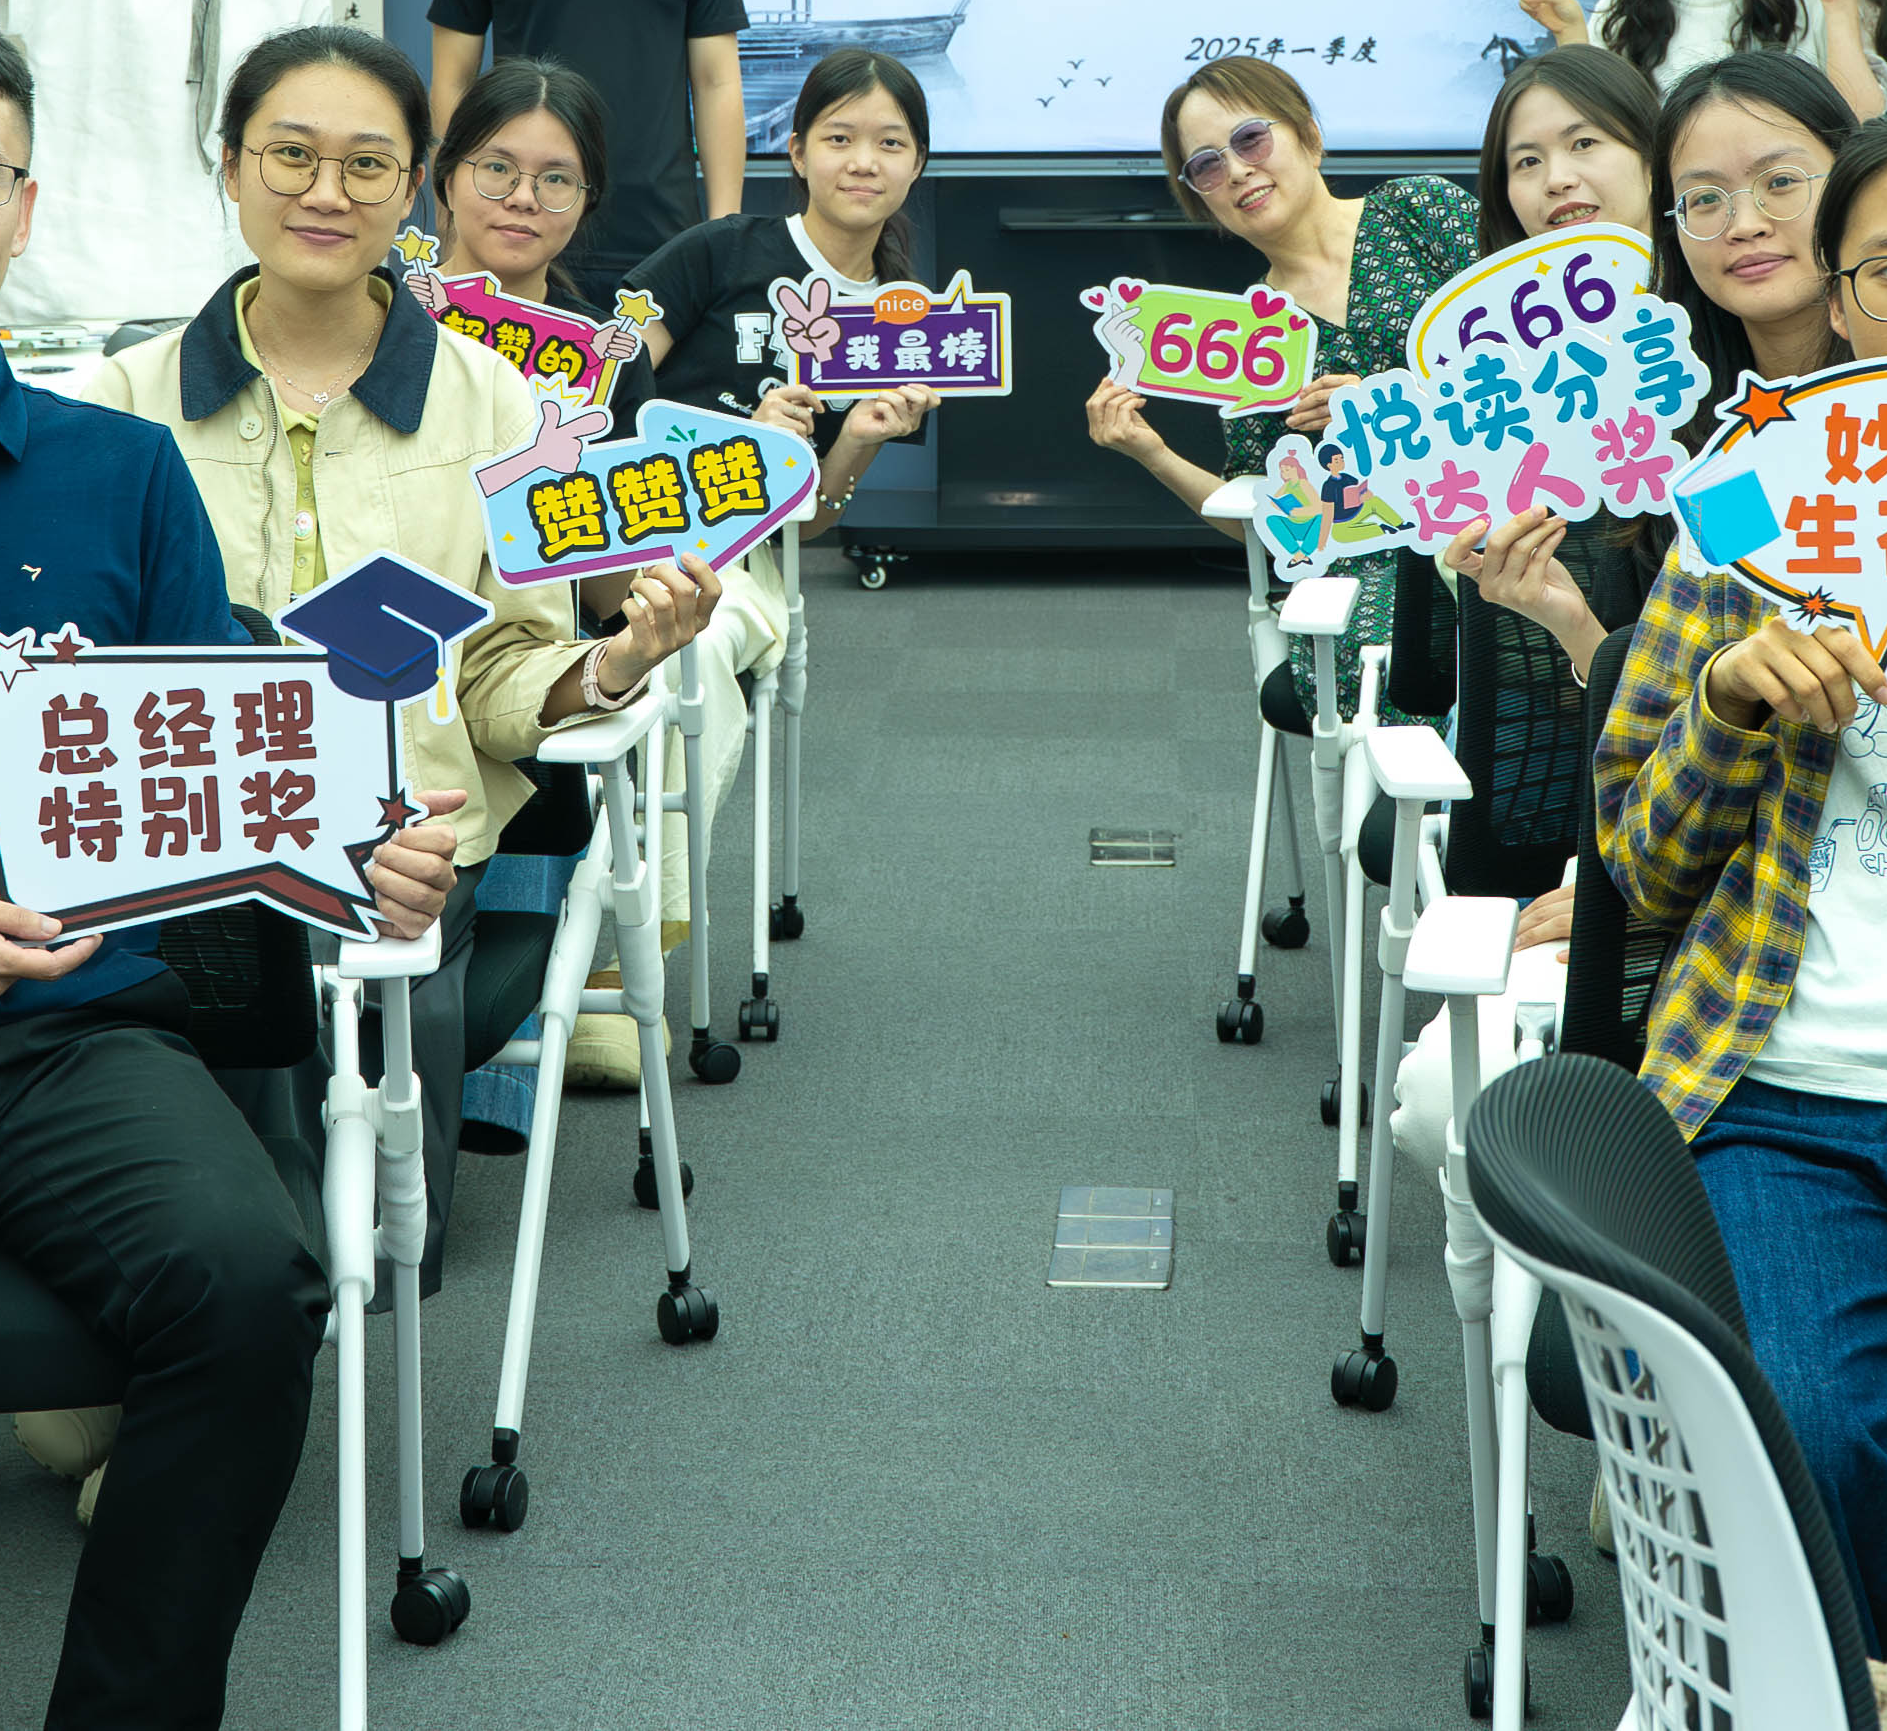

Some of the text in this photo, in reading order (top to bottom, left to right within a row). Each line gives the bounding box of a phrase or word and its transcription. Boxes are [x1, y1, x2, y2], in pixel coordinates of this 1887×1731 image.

[1185, 35, 1378, 65] 2025年一季度
[878, 294, 926, 313] nice
[1458, 251, 1617, 351] 666
[845, 326, 988, 373] 我最棒
[1149, 312, 1286, 388] 666
[1336, 307, 1696, 477] 悦读分享
[530, 435, 769, 562] 赞赞赞
[1404, 405, 1675, 542] 达人奖
[38, 679, 318, 776] 总经理
[37, 768, 320, 863] 特别奖
